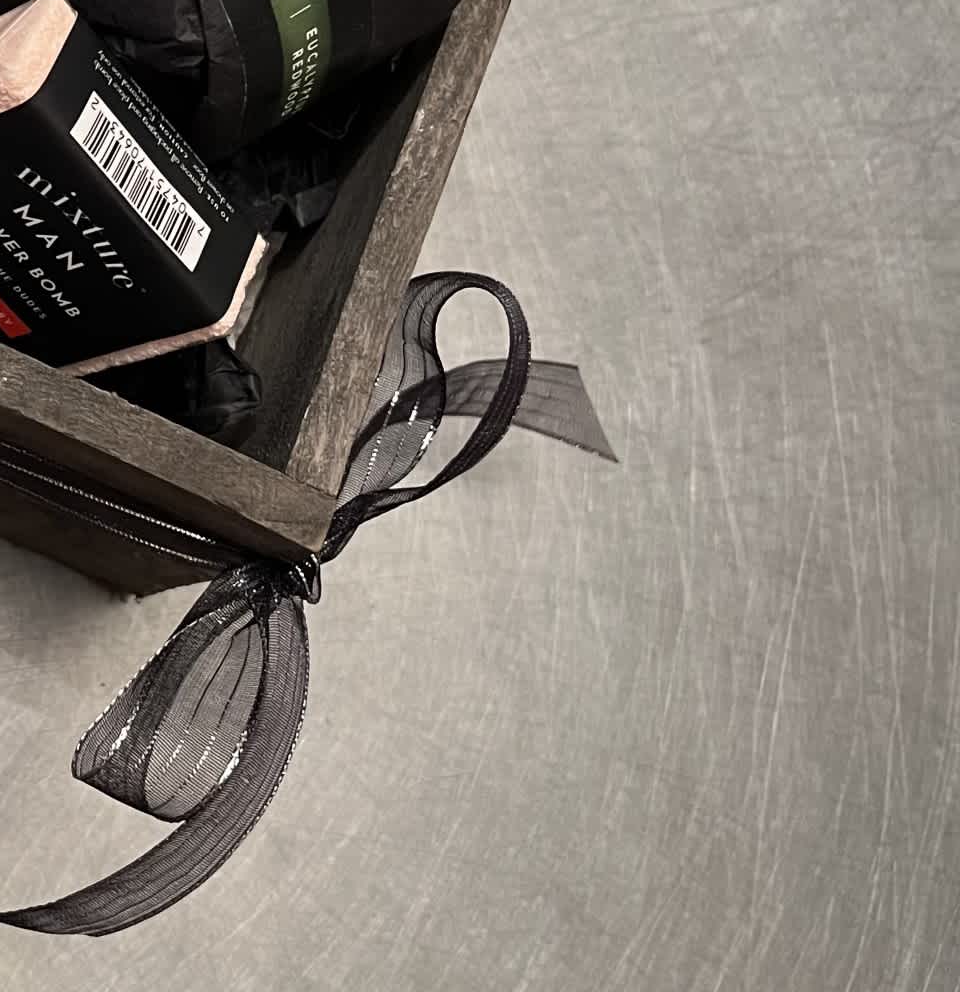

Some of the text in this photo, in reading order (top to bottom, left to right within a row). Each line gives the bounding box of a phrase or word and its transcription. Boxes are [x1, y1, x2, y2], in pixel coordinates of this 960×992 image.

[91, 97, 100, 111] 2
[110, 121, 145, 168] 70643
[149, 169, 187, 215] 04751
[13, 204, 84, 271] MAN
[17, 167, 134, 288] mixture
[29, 267, 80, 317] BOMB
